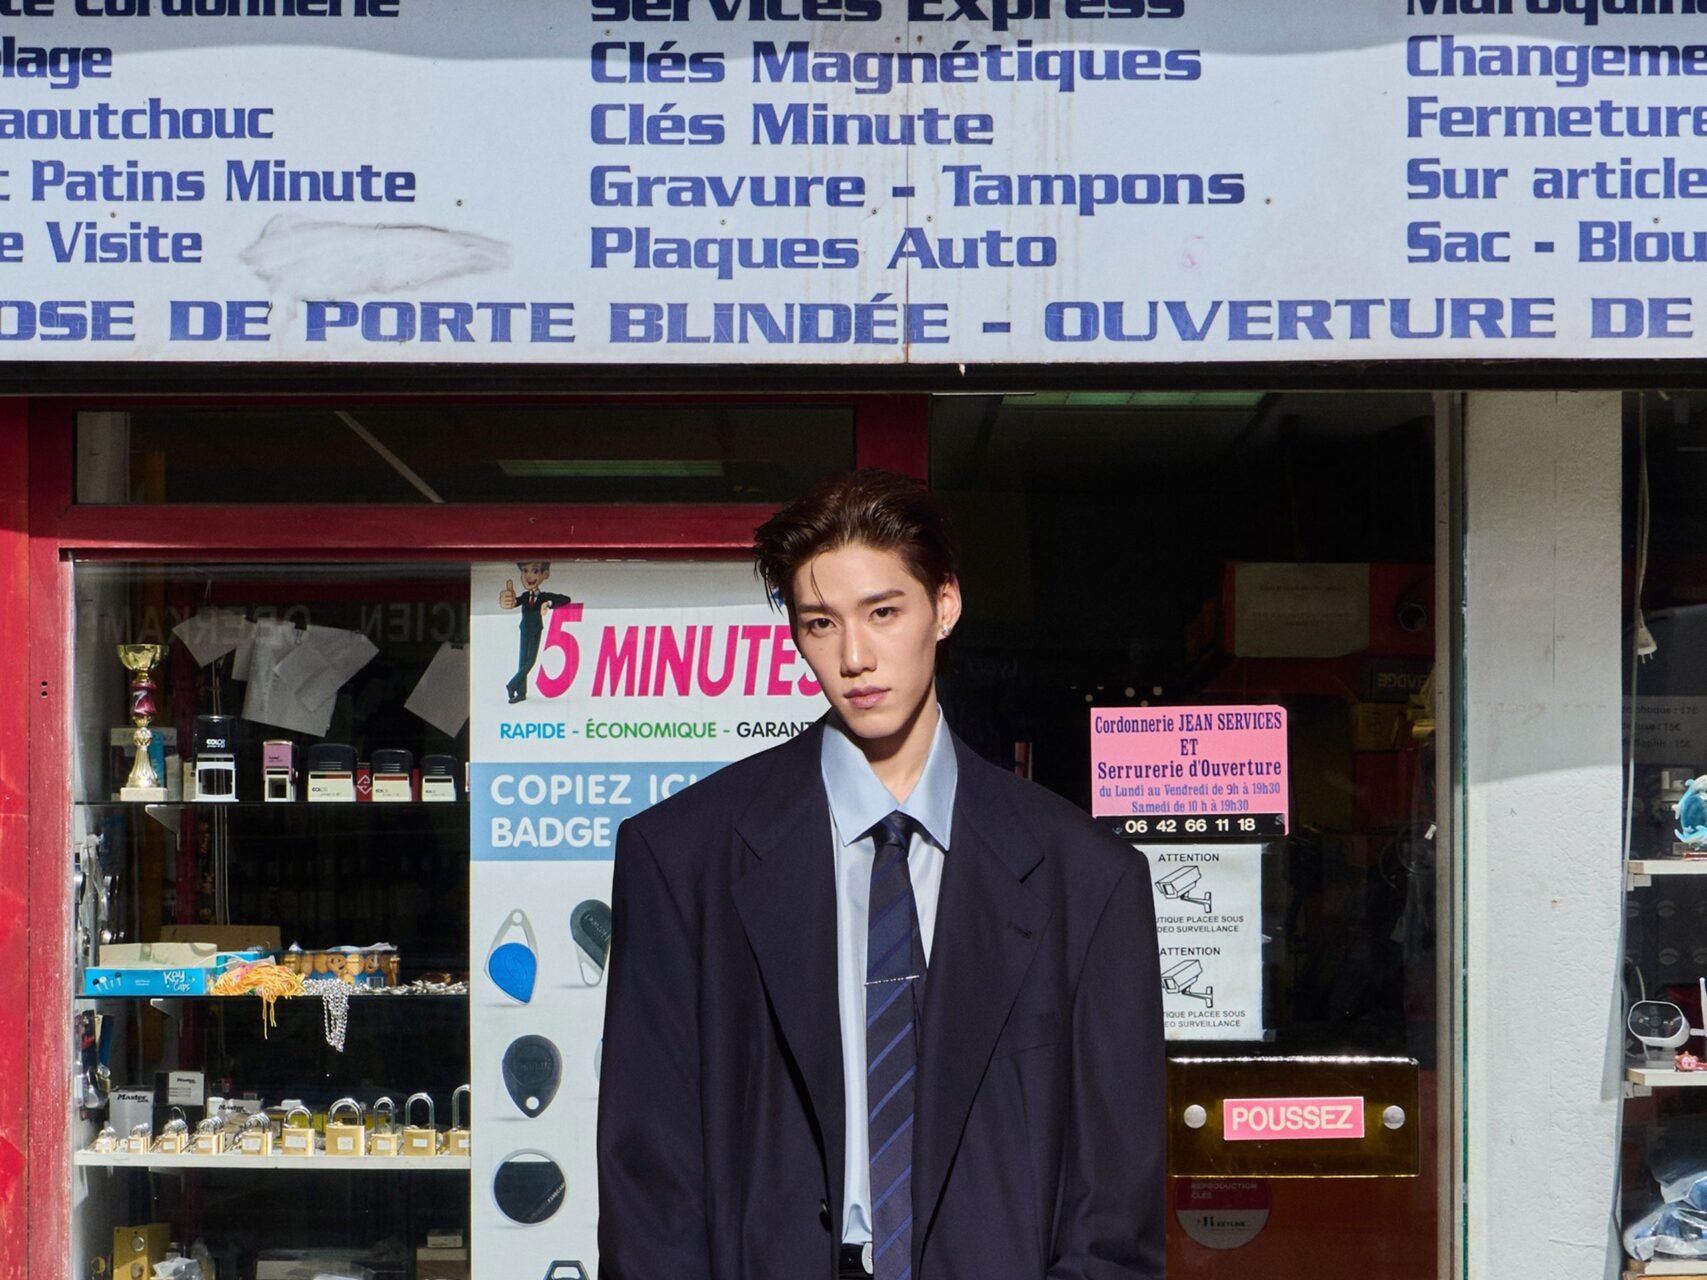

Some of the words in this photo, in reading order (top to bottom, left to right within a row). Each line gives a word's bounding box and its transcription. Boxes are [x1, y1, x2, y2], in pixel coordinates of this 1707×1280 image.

[0, 36, 112, 89] lage
[591, 41, 724, 82] Clés
[752, 38, 1201, 94] Magnétiques
[591, 103, 725, 145] Clés
[753, 103, 993, 145] Minute
[32, 160, 205, 201] Patins
[226, 160, 415, 202] Minute
[1407, 158, 1508, 199] Sur
[591, 166, 865, 207] Gravure
[942, 165, 1245, 216] Tampons
[46, 222, 202, 263] Visite
[1407, 221, 1510, 263] Sac
[1578, 221, 1707, 262] Blou
[590, 227, 858, 280] Plaques
[887, 227, 1057, 269] Auto
[169, 301, 271, 342] DE
[305, 302, 575, 343] PORTE
[609, 293, 950, 345] BLINDÉE
[1044, 297, 1557, 344] OUVERTURE
[1591, 297, 1694, 339] DE
[501, 724, 565, 739] RAPIDE
[586, 719, 716, 739] ÉCONOMIQUE
[1095, 715, 1174, 733] Cordonnerie
[1179, 714, 1212, 732] JEAN
[1218, 712, 1282, 730] SERVICES
[1180, 739, 1198, 756] ET
[1098, 761, 1183, 779] Serrurerie
[1189, 759, 1282, 777] d'Ouverture
[491, 775, 632, 805] COPIEZ
[650, 774, 696, 805] IC
[1100, 786, 1111, 797] du
[1115, 785, 1144, 797] Lundi
[1148, 786, 1160, 795] au
[1164, 783, 1208, 796] Vendredi
[1212, 784, 1223, 795] de
[1227, 784, 1239, 795] 9h
[1243, 783, 1248, 794] à
[1253, 782, 1280, 794] 19h30
[1131, 800, 1170, 813] Samedi
[1174, 800, 1185, 812] de
[1188, 800, 1198, 811] 10
[1211, 799, 1217, 811] à
[1221, 799, 1248, 811] 19h30
[491, 816, 611, 848] BADGE
[1125, 820, 1148, 833] 06
[1156, 820, 1177, 832] 42
[1185, 819, 1207, 832] 66
[1216, 819, 1229, 831] 11
[1238, 818, 1256, 831] 18
[1158, 853, 1220, 862] ATTENTION
[1176, 925, 1239, 933] SURVEILLANCE
[1221, 915, 1244, 923] SOUS
[1160, 947, 1221, 956] ATTENTION
[163, 970, 186, 986] Key
[1178, 1020, 1241, 1028] SURVEILLANCE
[1188, 1010, 1220, 1018] PLACEE
[1223, 1010, 1246, 1018] SOUS
[1232, 1105, 1353, 1130] POUSSEZ
